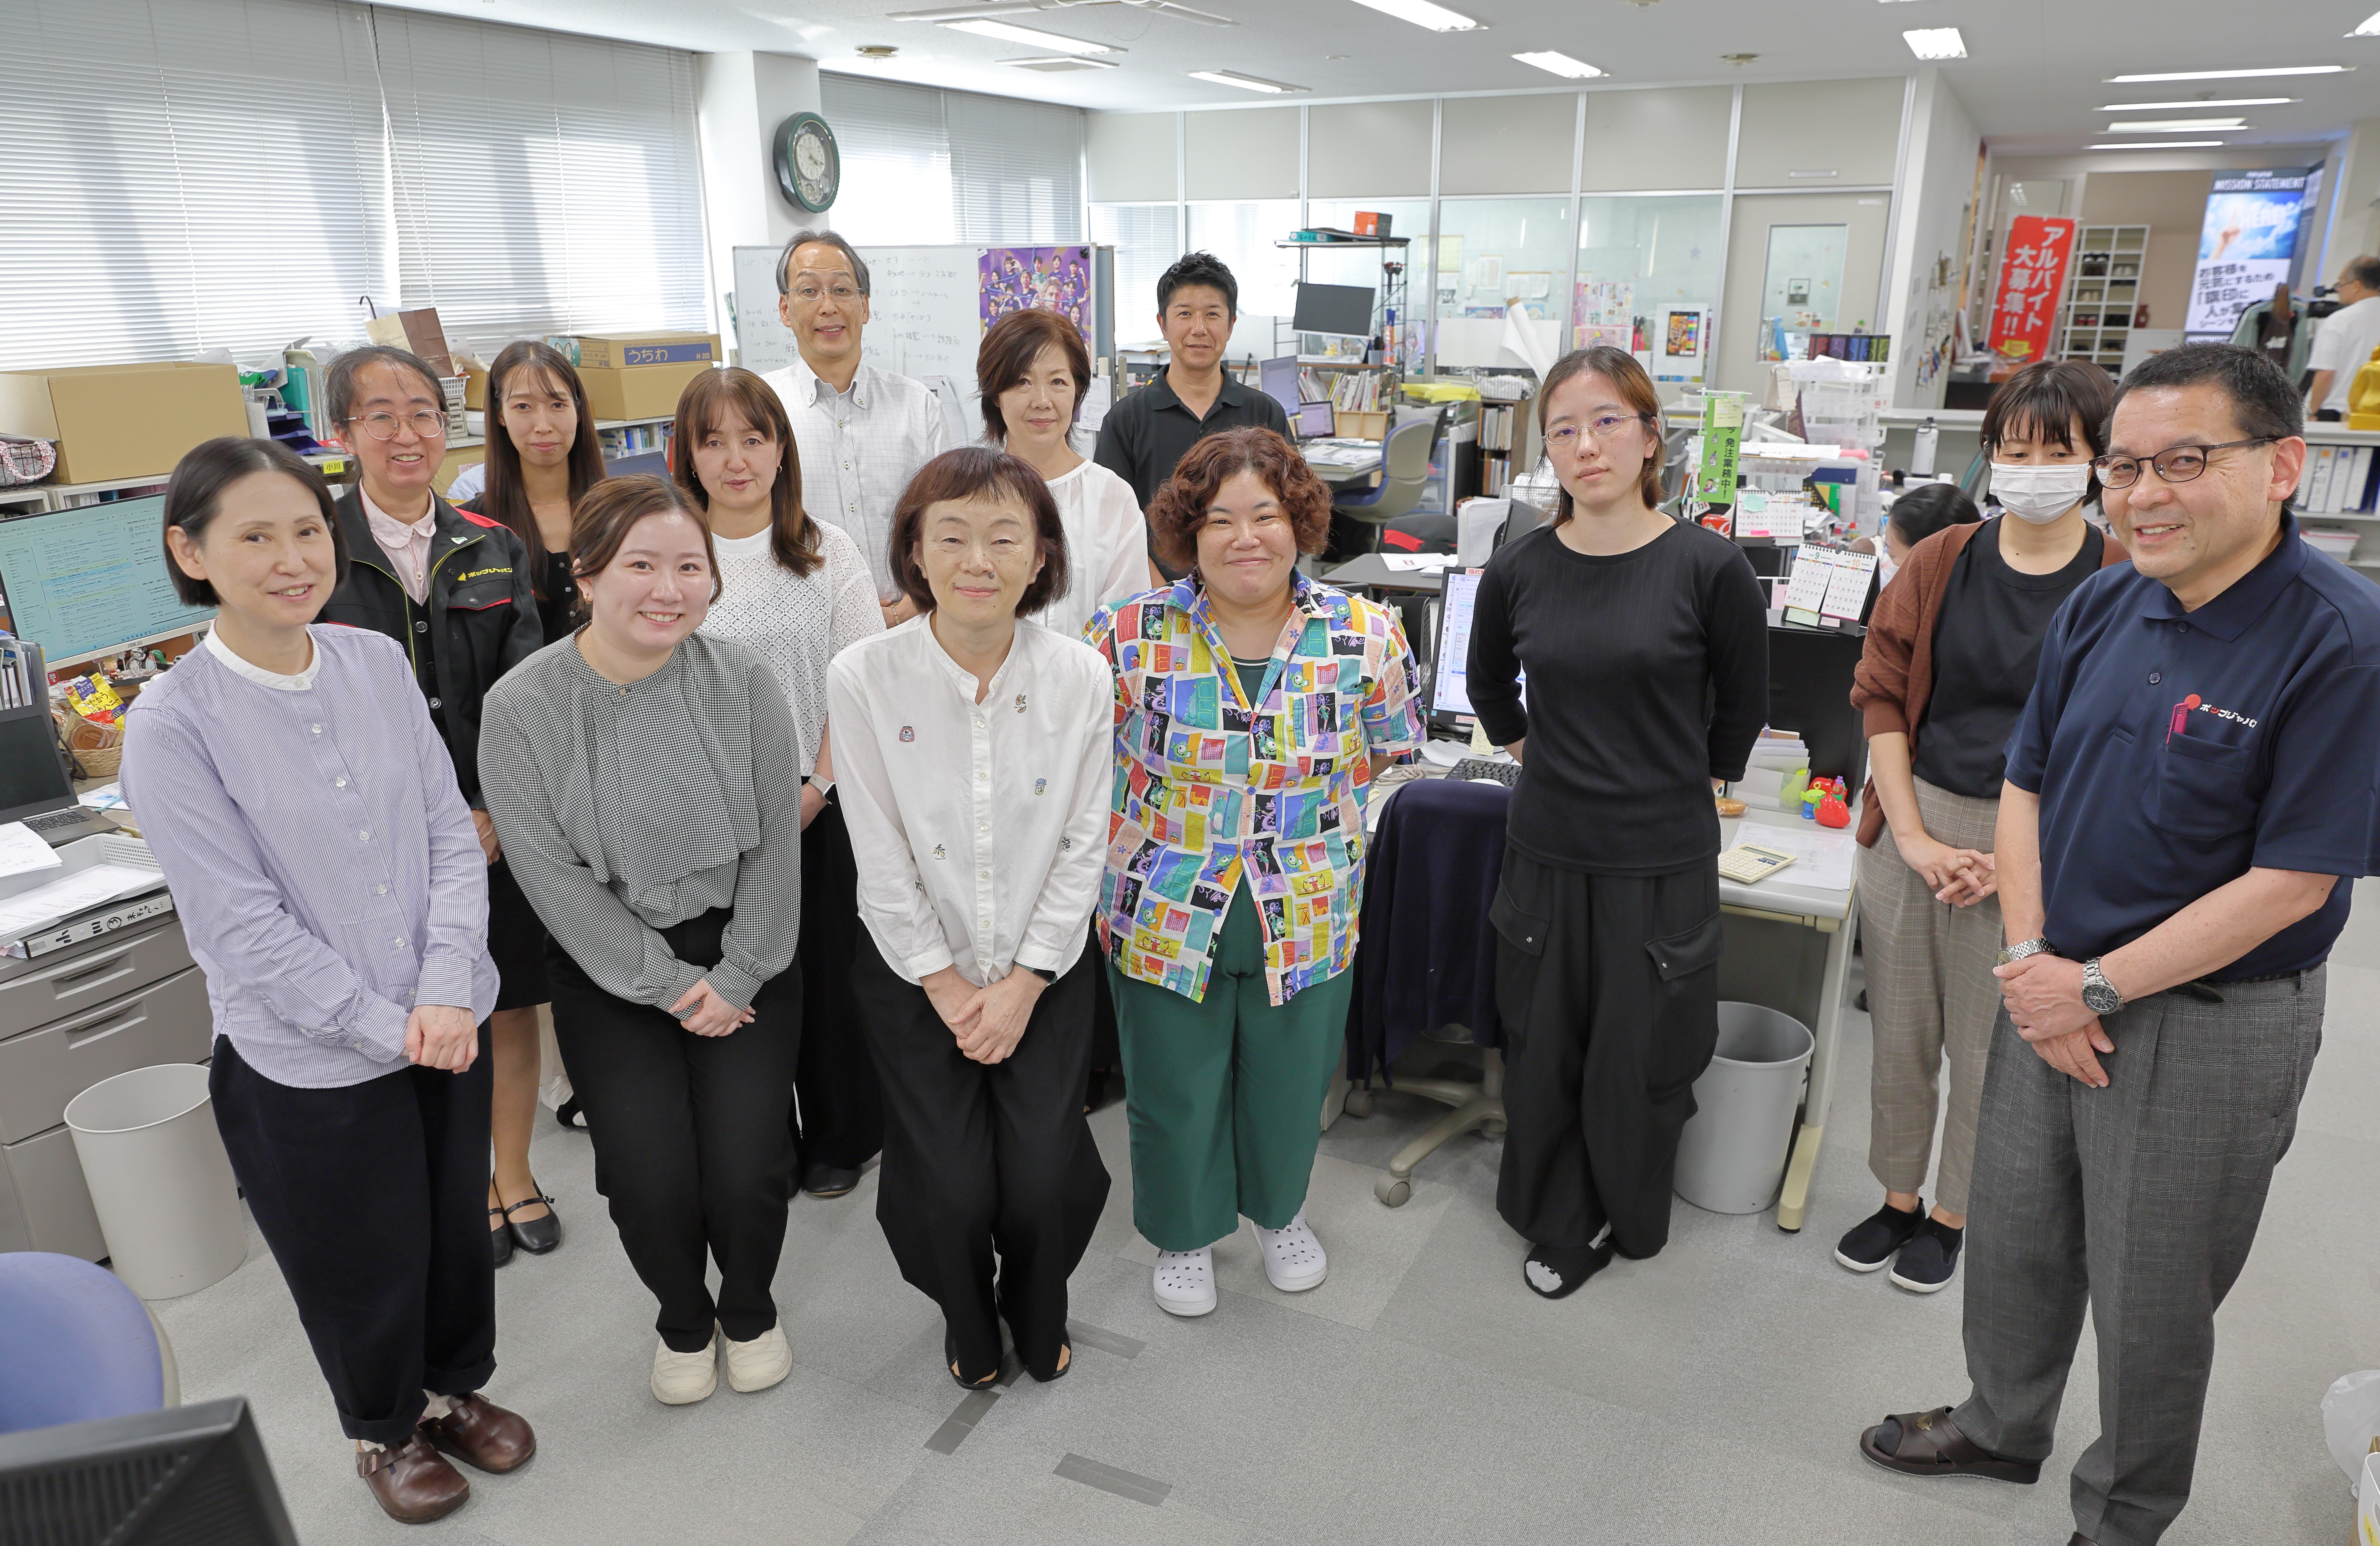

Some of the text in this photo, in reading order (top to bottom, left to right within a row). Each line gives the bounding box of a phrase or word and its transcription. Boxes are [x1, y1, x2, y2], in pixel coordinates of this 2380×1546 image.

[2213, 177, 2306, 191] MISSION STATEMENT
[2025, 226, 2066, 333] アルバイト
[628, 348, 711, 363] うちわ H-200
[326, 462, 341, 471] 小川
[1852, 559, 1860, 567] 10
[468, 568, 513, 578] ポップジャパン
[127, 640, 143, 649] ASUS
